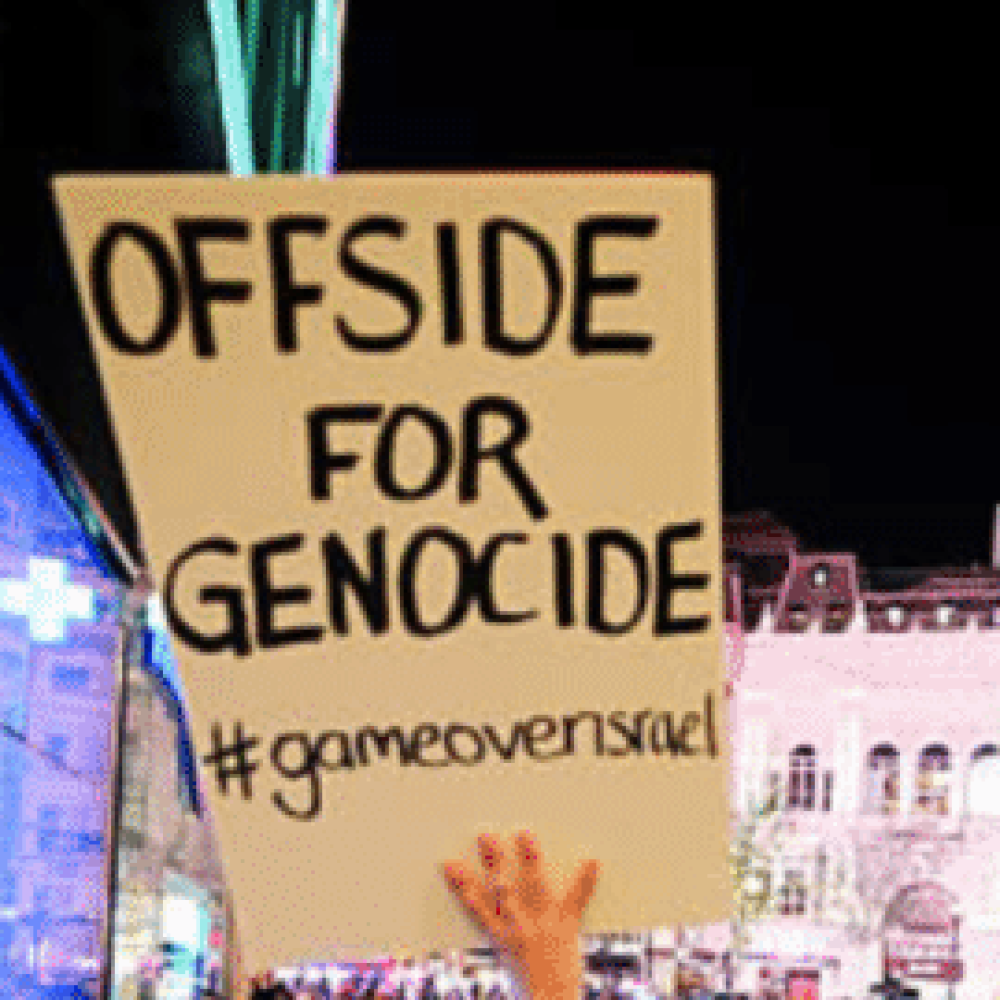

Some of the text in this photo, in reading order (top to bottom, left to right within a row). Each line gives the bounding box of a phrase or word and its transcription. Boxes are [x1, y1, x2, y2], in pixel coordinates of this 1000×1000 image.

[87, 213, 661, 361] OFFSIDE
[302, 394, 550, 524] FOR
[161, 520, 713, 661] GENOCIDE
[202, 690, 719, 823] #gameoverisrael
